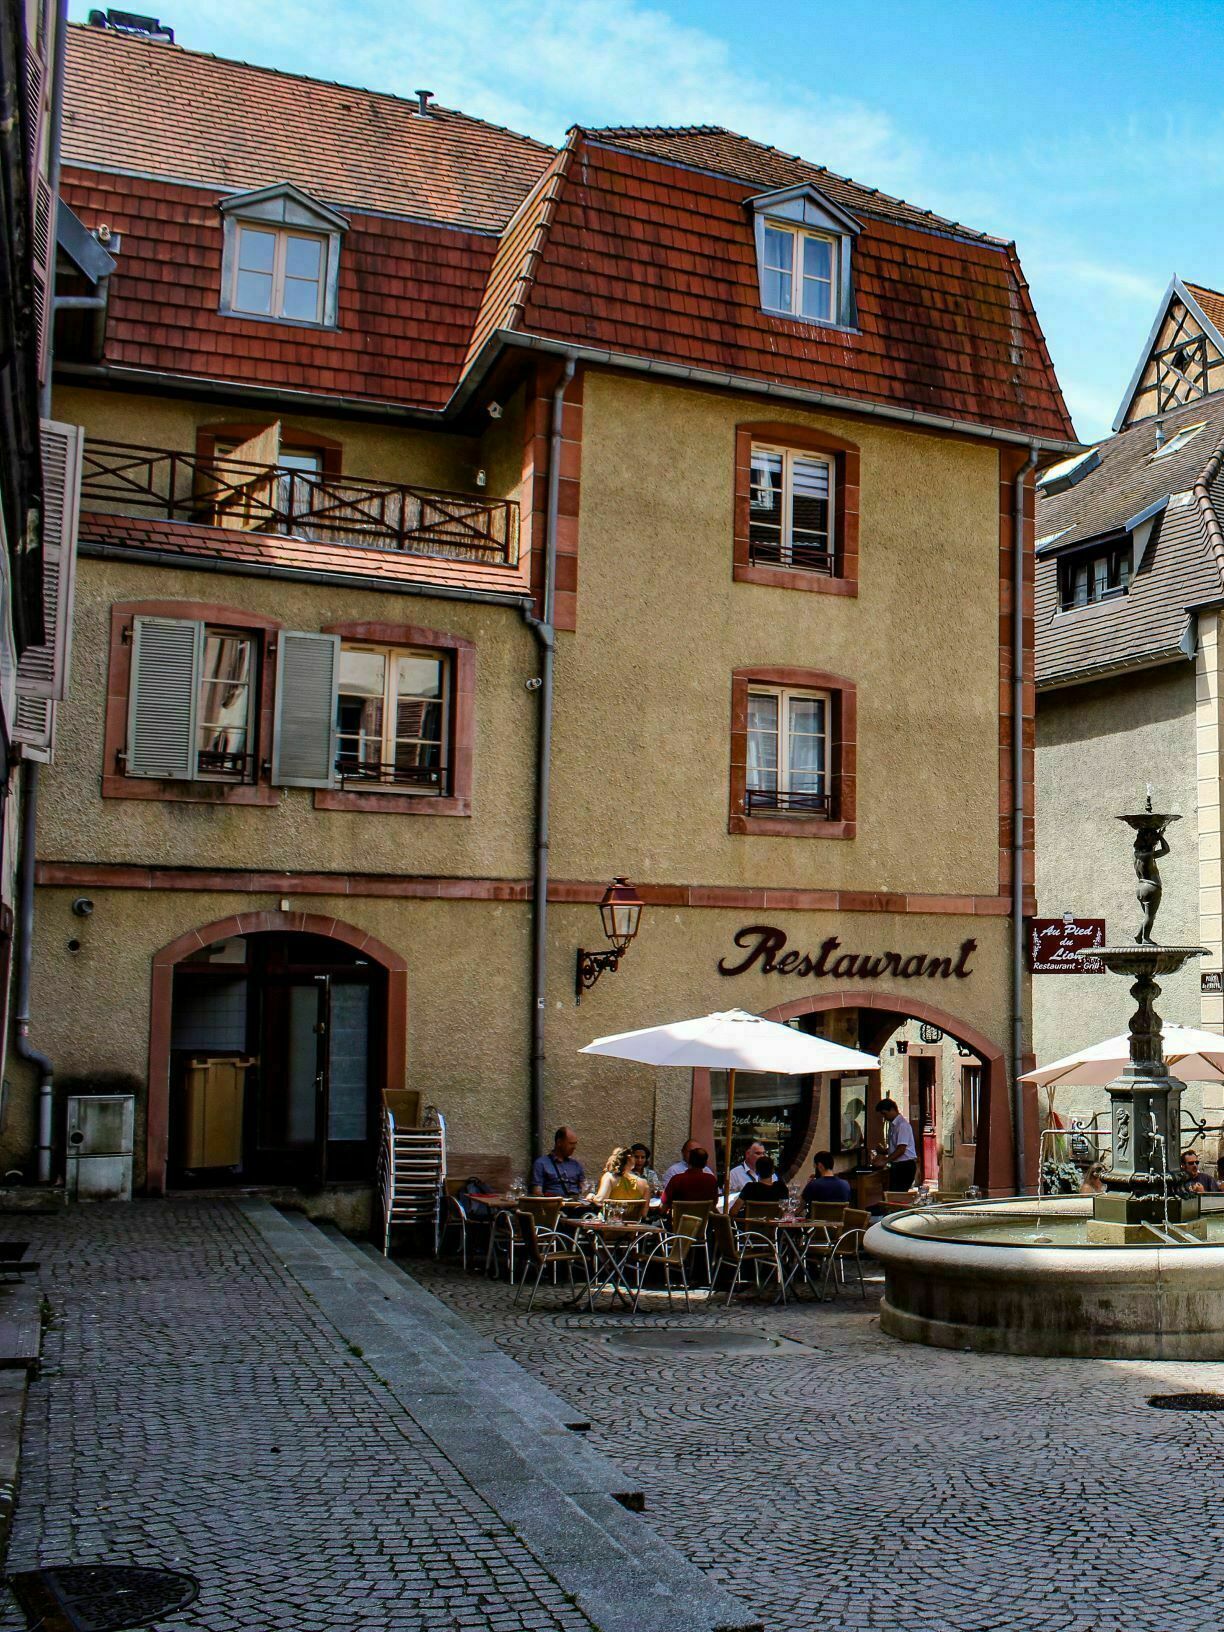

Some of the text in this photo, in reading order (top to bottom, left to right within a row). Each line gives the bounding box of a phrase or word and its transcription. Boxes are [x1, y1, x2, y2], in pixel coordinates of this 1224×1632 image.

[1040, 925, 1093, 936] Au Pied
[1060, 938, 1073, 946] du
[718, 926, 977, 979] Restaurant
[1033, 962, 1076, 970] Restaurant
